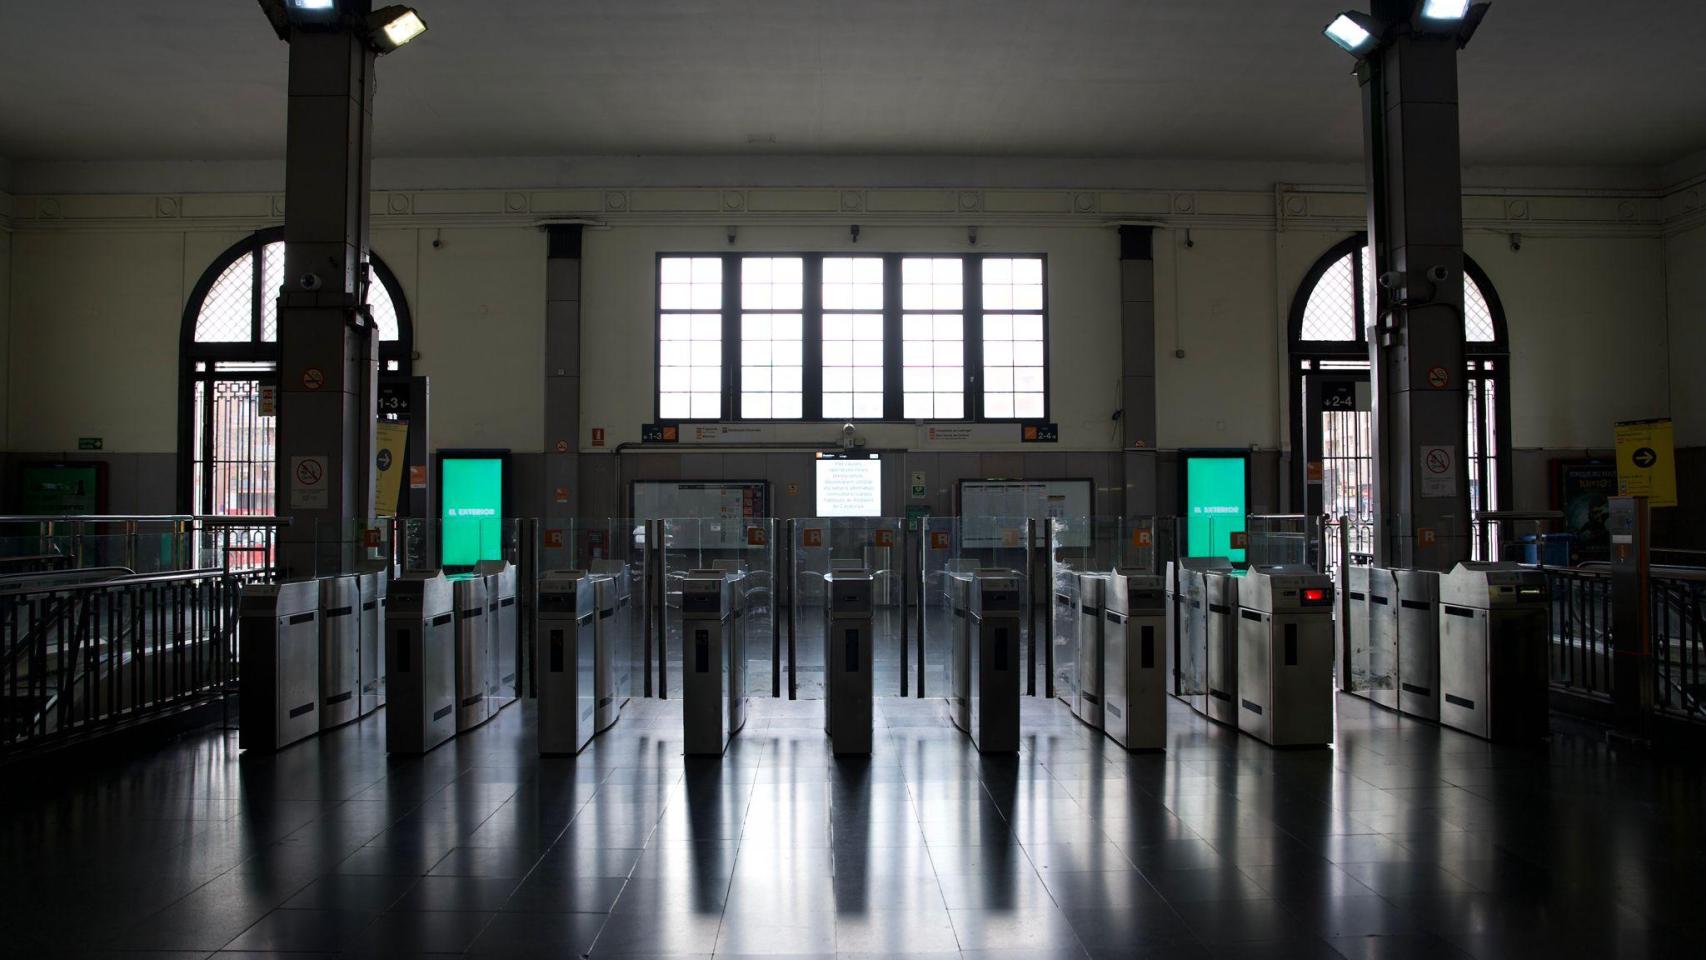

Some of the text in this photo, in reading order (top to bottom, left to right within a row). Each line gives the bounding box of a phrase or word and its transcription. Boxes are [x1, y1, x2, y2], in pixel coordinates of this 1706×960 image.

[378, 397, 399, 409] 1-3
[1332, 395, 1352, 407] 2-4
[648, 432, 663, 441] 1-3
[1038, 432, 1052, 440] 2-4
[551, 531, 562, 544] R
[754, 530, 766, 543] R
[810, 532, 822, 544] R
[882, 532, 893, 544] R
[937, 534, 948, 545] R
[1139, 532, 1151, 544] R
[1236, 536, 1248, 545] R
[1425, 530, 1436, 542] R
